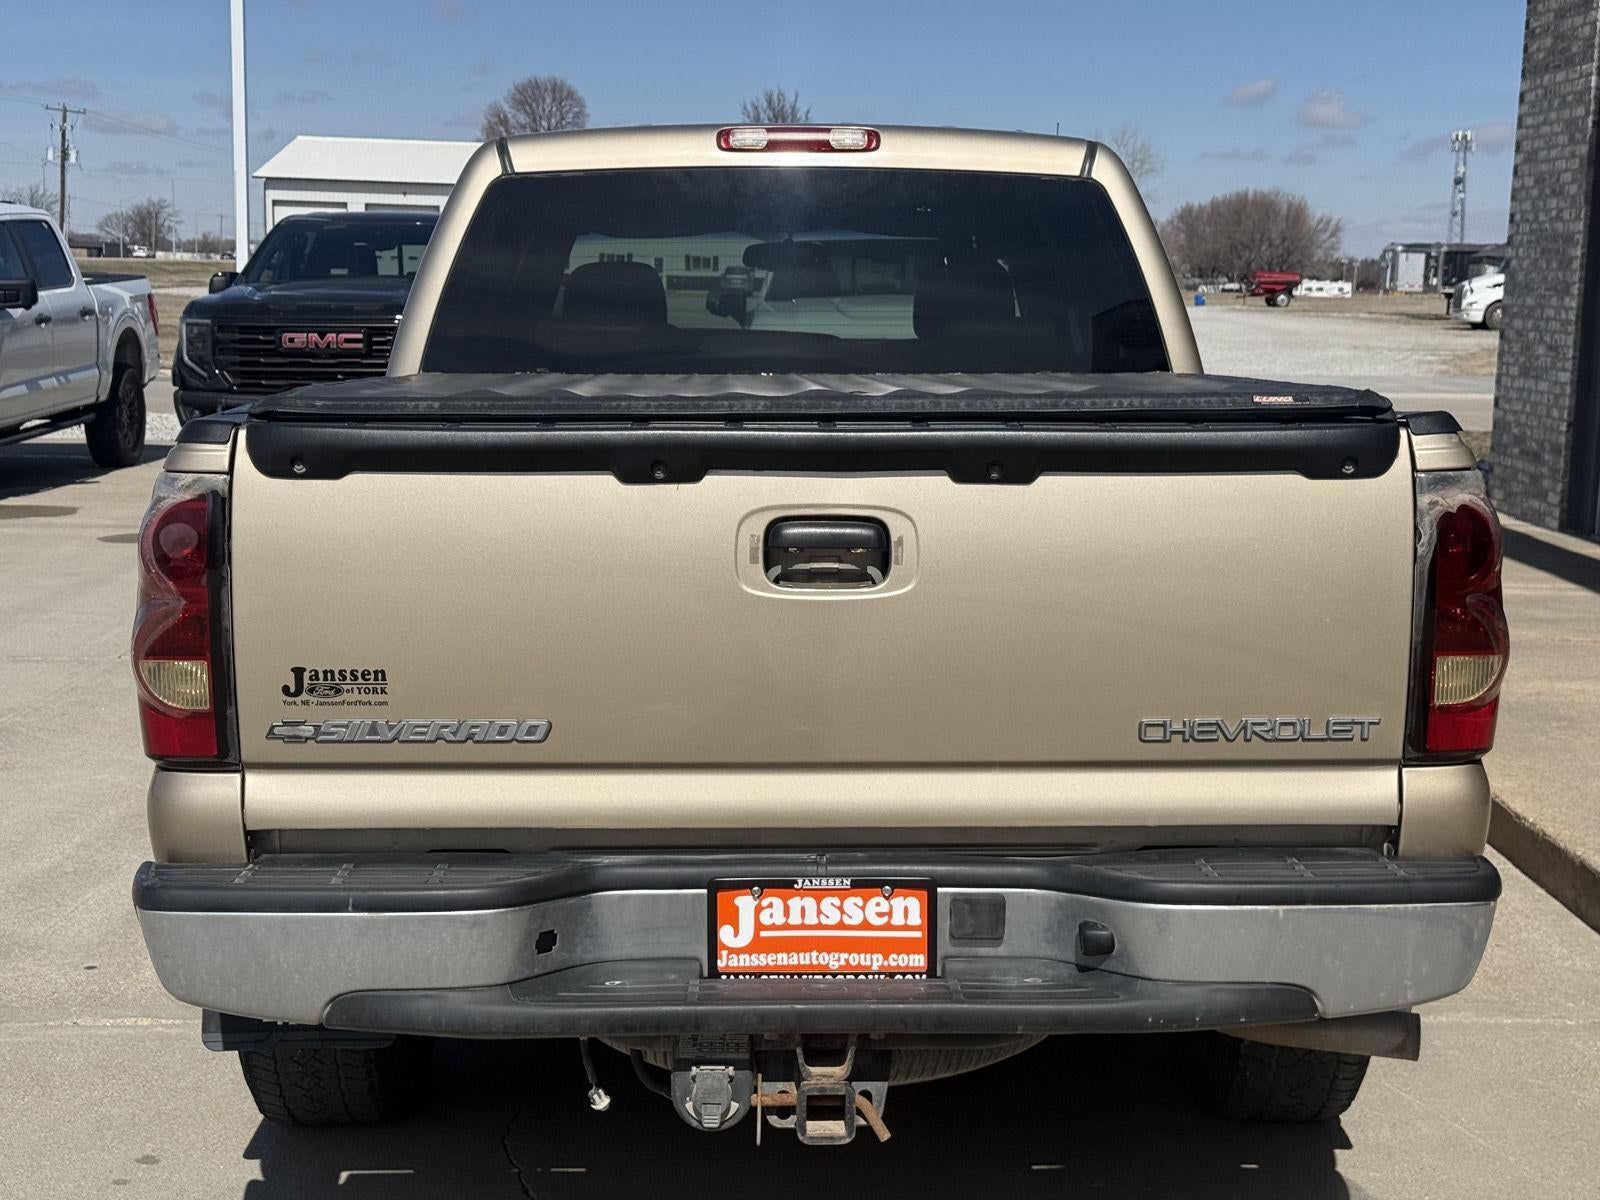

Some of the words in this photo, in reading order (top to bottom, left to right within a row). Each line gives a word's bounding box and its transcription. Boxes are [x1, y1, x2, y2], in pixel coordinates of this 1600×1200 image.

[281, 333, 364, 349] GMC
[282, 666, 388, 698] Janssen
[345, 686, 355, 695] of
[356, 686, 388, 695] YORK
[315, 719, 552, 744] SILVERADO
[1138, 717, 1381, 742] CHEVROLET
[794, 878, 851, 889] JANSSEN
[719, 895, 922, 949] Janssen
[718, 949, 925, 970] Janssenautogroup.com
